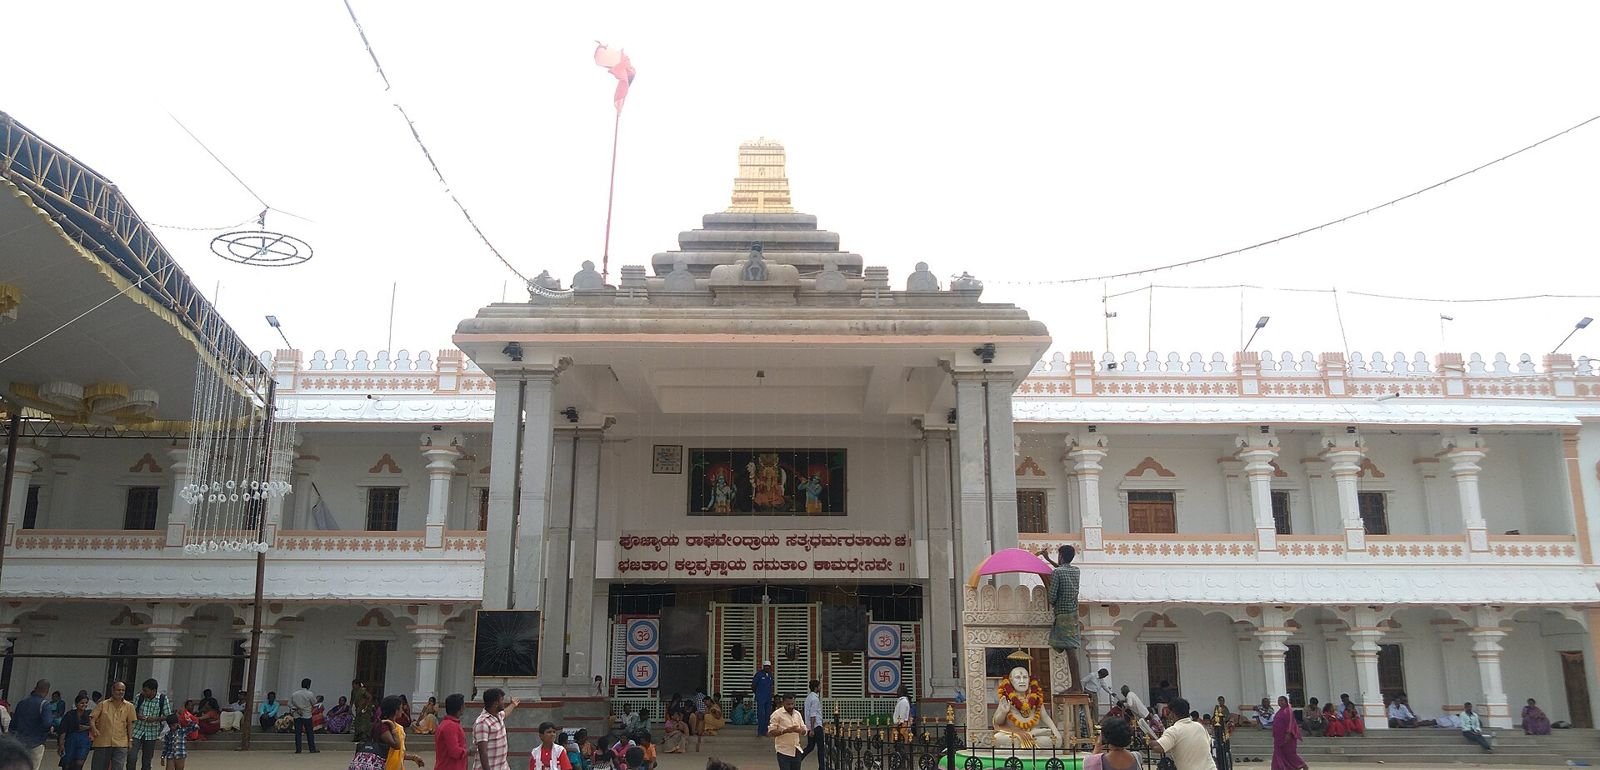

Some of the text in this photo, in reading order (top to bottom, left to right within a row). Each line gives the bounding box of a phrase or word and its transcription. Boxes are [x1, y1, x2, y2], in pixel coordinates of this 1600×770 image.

[618, 533, 680, 552] ಪೂಜ್ಯಾಯ
[685, 533, 780, 551] ರಾಘವೇಂದ್ರಾಯ
[786, 533, 892, 552] ಸತ್ಯಧರ್ಮರತಾಯ
[617, 558, 669, 573] ಭಜತಾಂ
[674, 558, 747, 577] ಕಲ್ಪವೃಕ್ಷಾಯ
[752, 558, 808, 572] ನಮತಾಂ
[813, 558, 893, 573] ಕಾಮಧೇನವೇ
